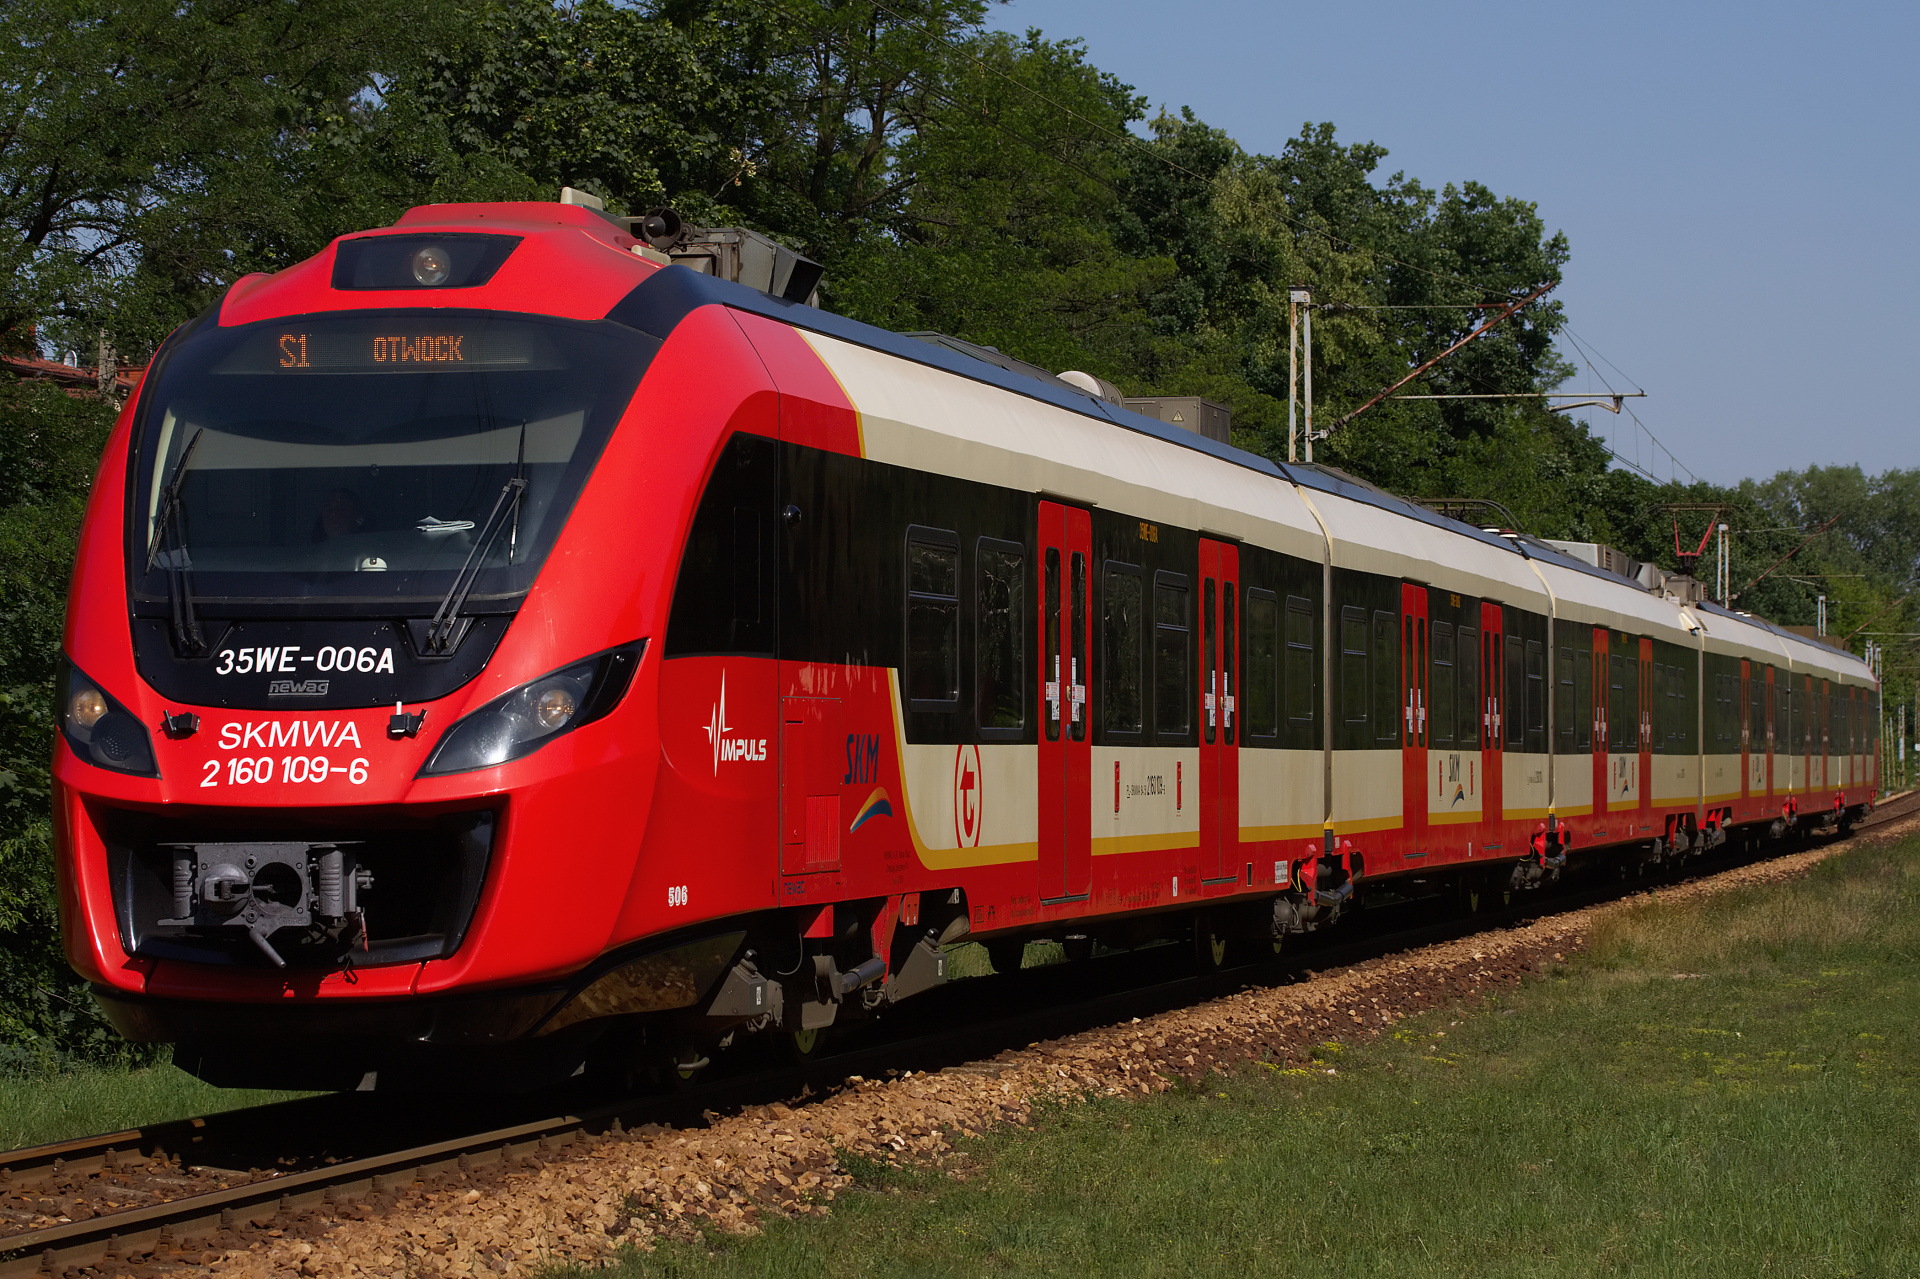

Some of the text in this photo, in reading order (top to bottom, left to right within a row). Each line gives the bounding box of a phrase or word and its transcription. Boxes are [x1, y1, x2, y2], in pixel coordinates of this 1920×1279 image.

[279, 334, 464, 368] S1 OTWOCK
[215, 645, 395, 675] 35WE-006A
[218, 720, 362, 750] SKMWA
[720, 739, 767, 762] IMPULS
[844, 733, 880, 785] SKM
[200, 755, 370, 788] 2 160 109-6
[668, 885, 688, 908] 506
